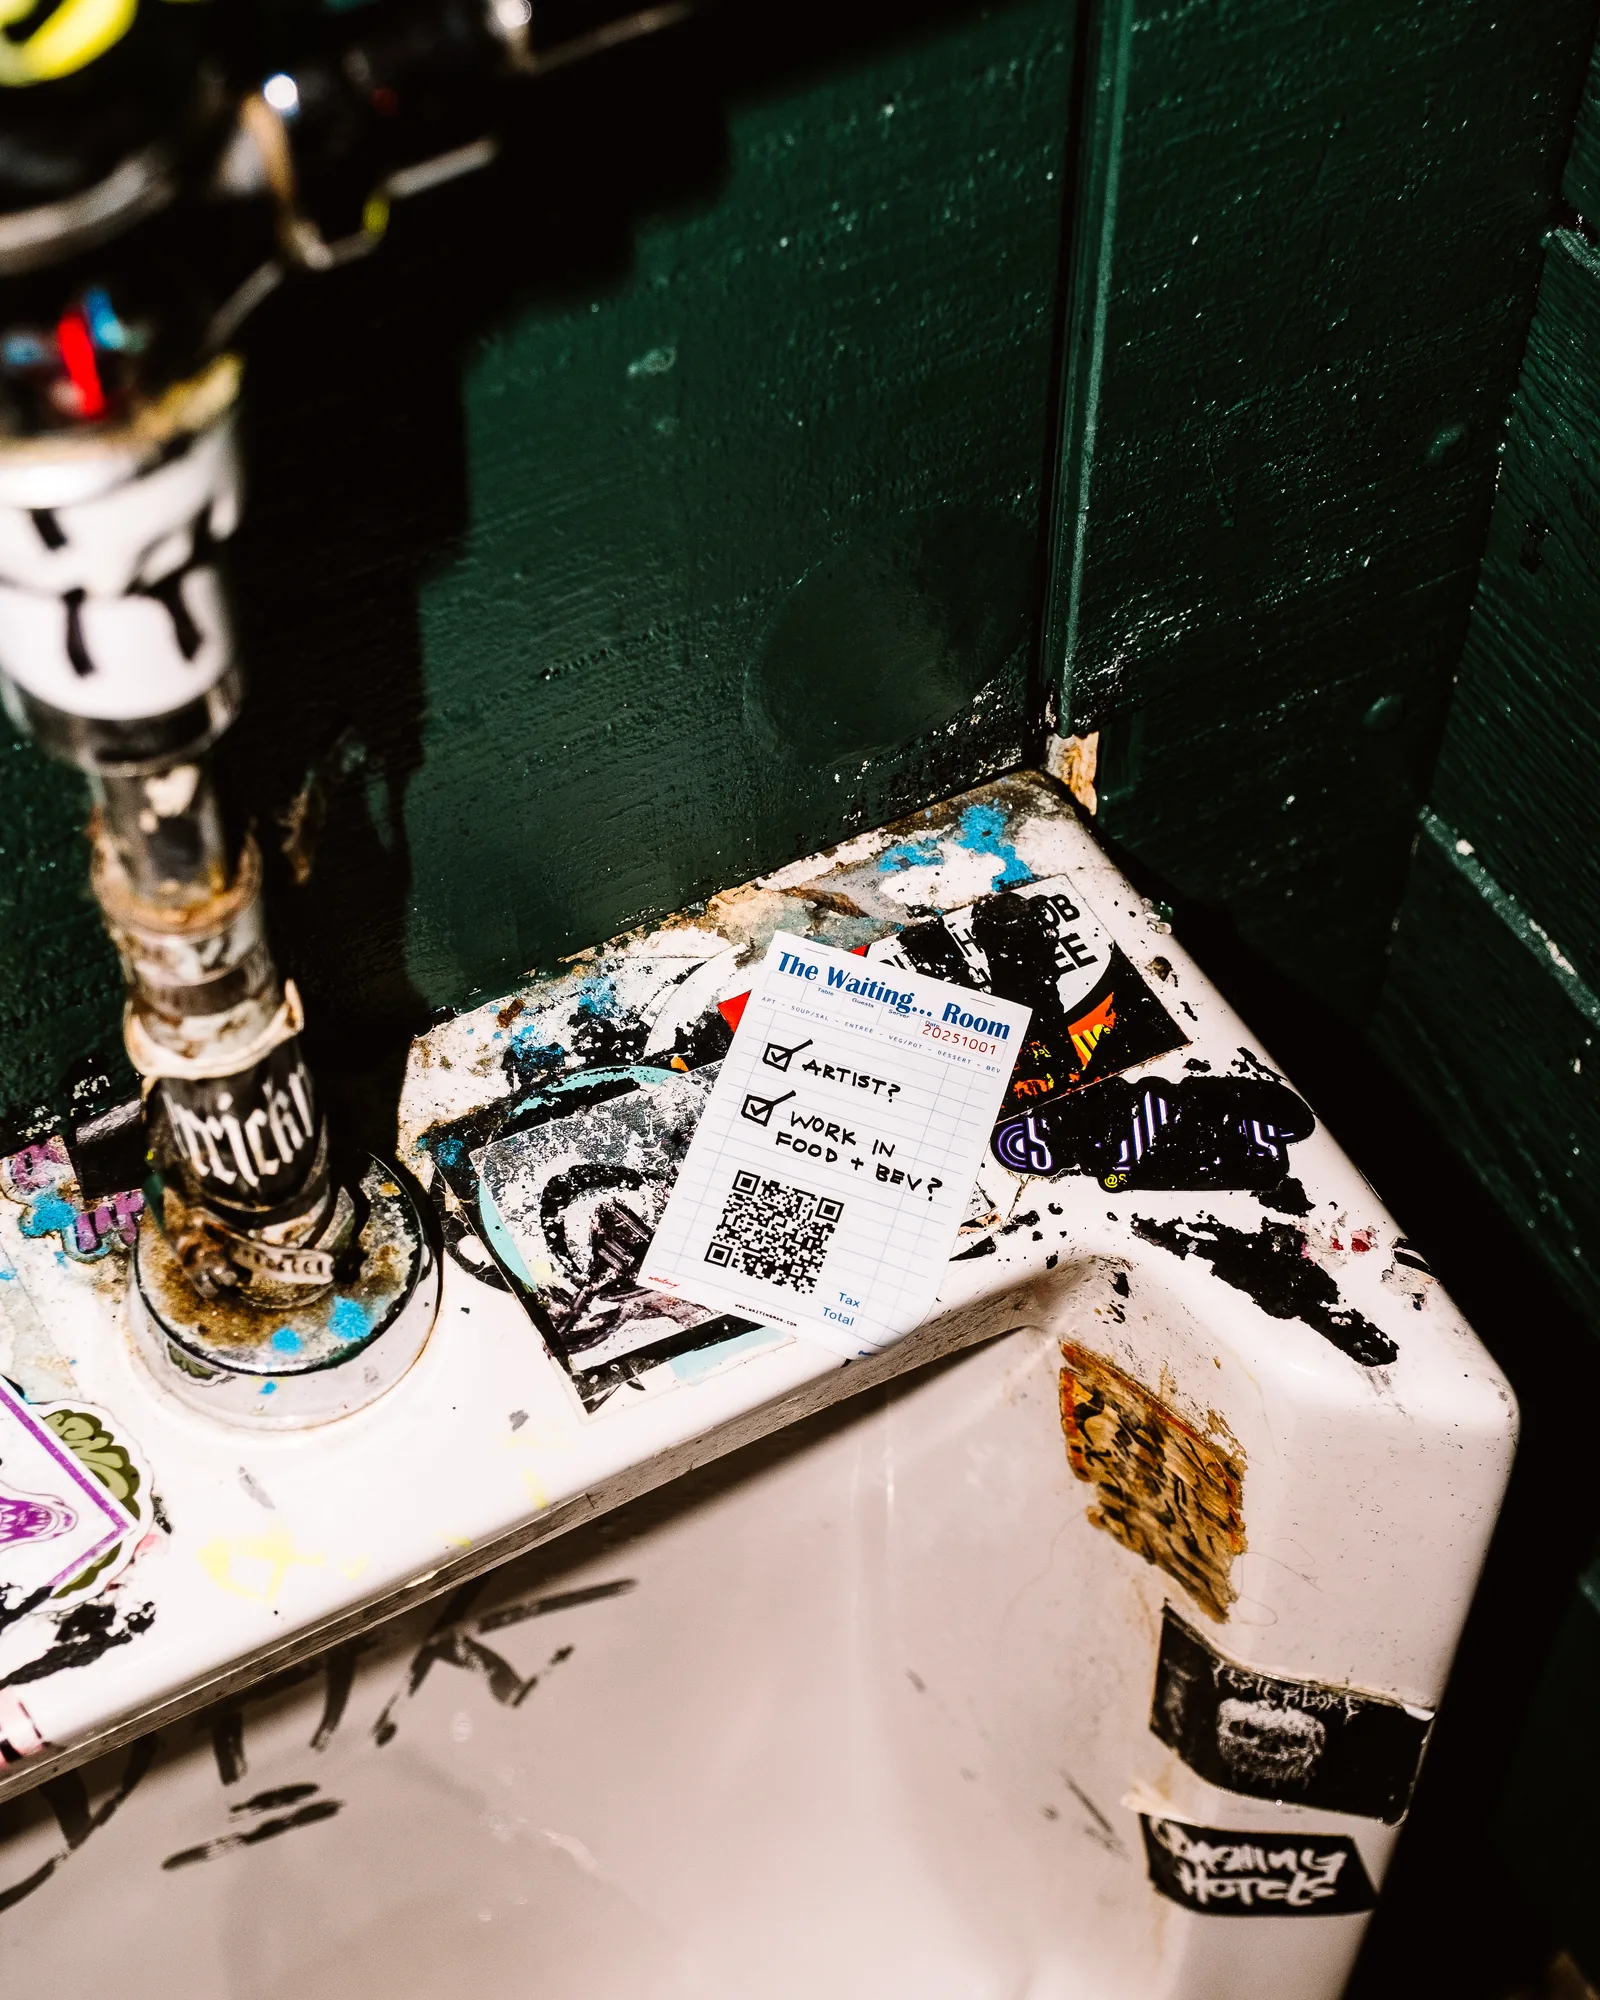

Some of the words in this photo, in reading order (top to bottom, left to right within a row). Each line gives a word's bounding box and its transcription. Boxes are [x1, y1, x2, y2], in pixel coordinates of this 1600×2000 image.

[778, 951, 819, 981] The
[827, 966, 932, 1014] Waiting...
[942, 1002, 1011, 1040] Room
[817, 987, 835, 997] Table
[852, 997, 875, 1009] Guests
[888, 1008, 910, 1019] Server
[925, 1020, 940, 1029] Date
[761, 996, 776, 1005] APT
[791, 1005, 829, 1021] SOUP/SAL
[845, 1021, 874, 1034] ENTREE
[888, 1035, 923, 1049] VEG/POT
[937, 1050, 971, 1065] DESSERT
[986, 1065, 1001, 1074] BEV
[922, 1023, 997, 1055] 20251001
[802, 1059, 901, 1103] ARTIST?
[790, 1111, 857, 1145] WORK
[872, 1139, 895, 1157] IN
[775, 1131, 838, 1162] FOOD
[876, 1163, 943, 1201] BEV?
[839, 1291, 861, 1308] Tax
[823, 1306, 855, 1326] Total
